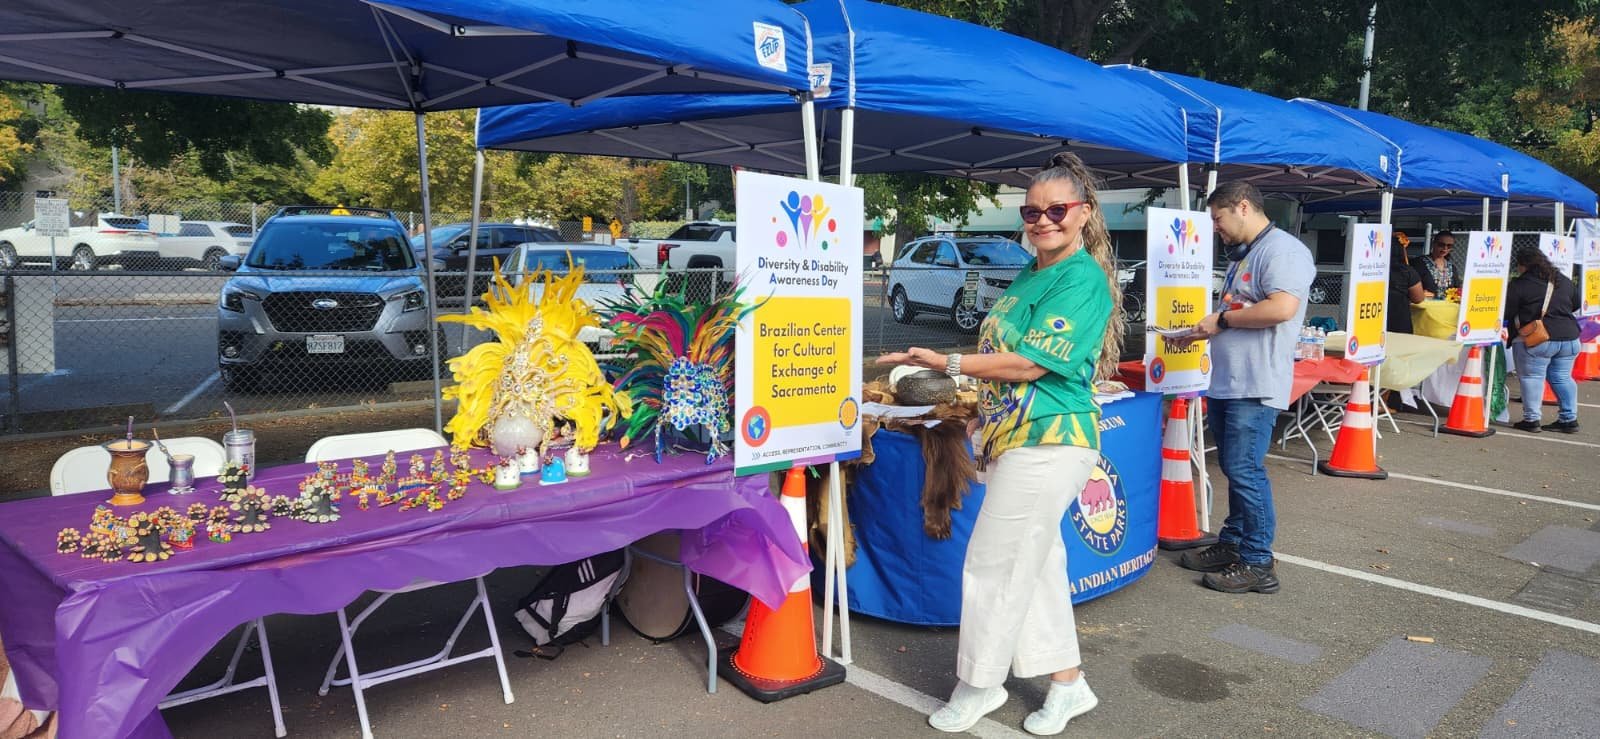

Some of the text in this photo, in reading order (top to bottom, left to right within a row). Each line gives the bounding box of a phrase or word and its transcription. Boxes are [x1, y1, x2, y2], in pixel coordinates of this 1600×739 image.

[758, 256, 849, 276] Diversity & Disability
[769, 272, 838, 289] Awareness Day
[1171, 300, 1195, 314] State
[1359, 301, 1383, 320] EEOP
[760, 322, 847, 337] Brazilian Center
[774, 341, 836, 357] for Cultural
[1023, 328, 1075, 362] BRAZIL
[771, 360, 837, 379] Exchange of
[771, 382, 837, 399] Sacramento
[1073, 499, 1126, 551] STATE PARKS
[1079, 566, 1119, 593] INDIAN
